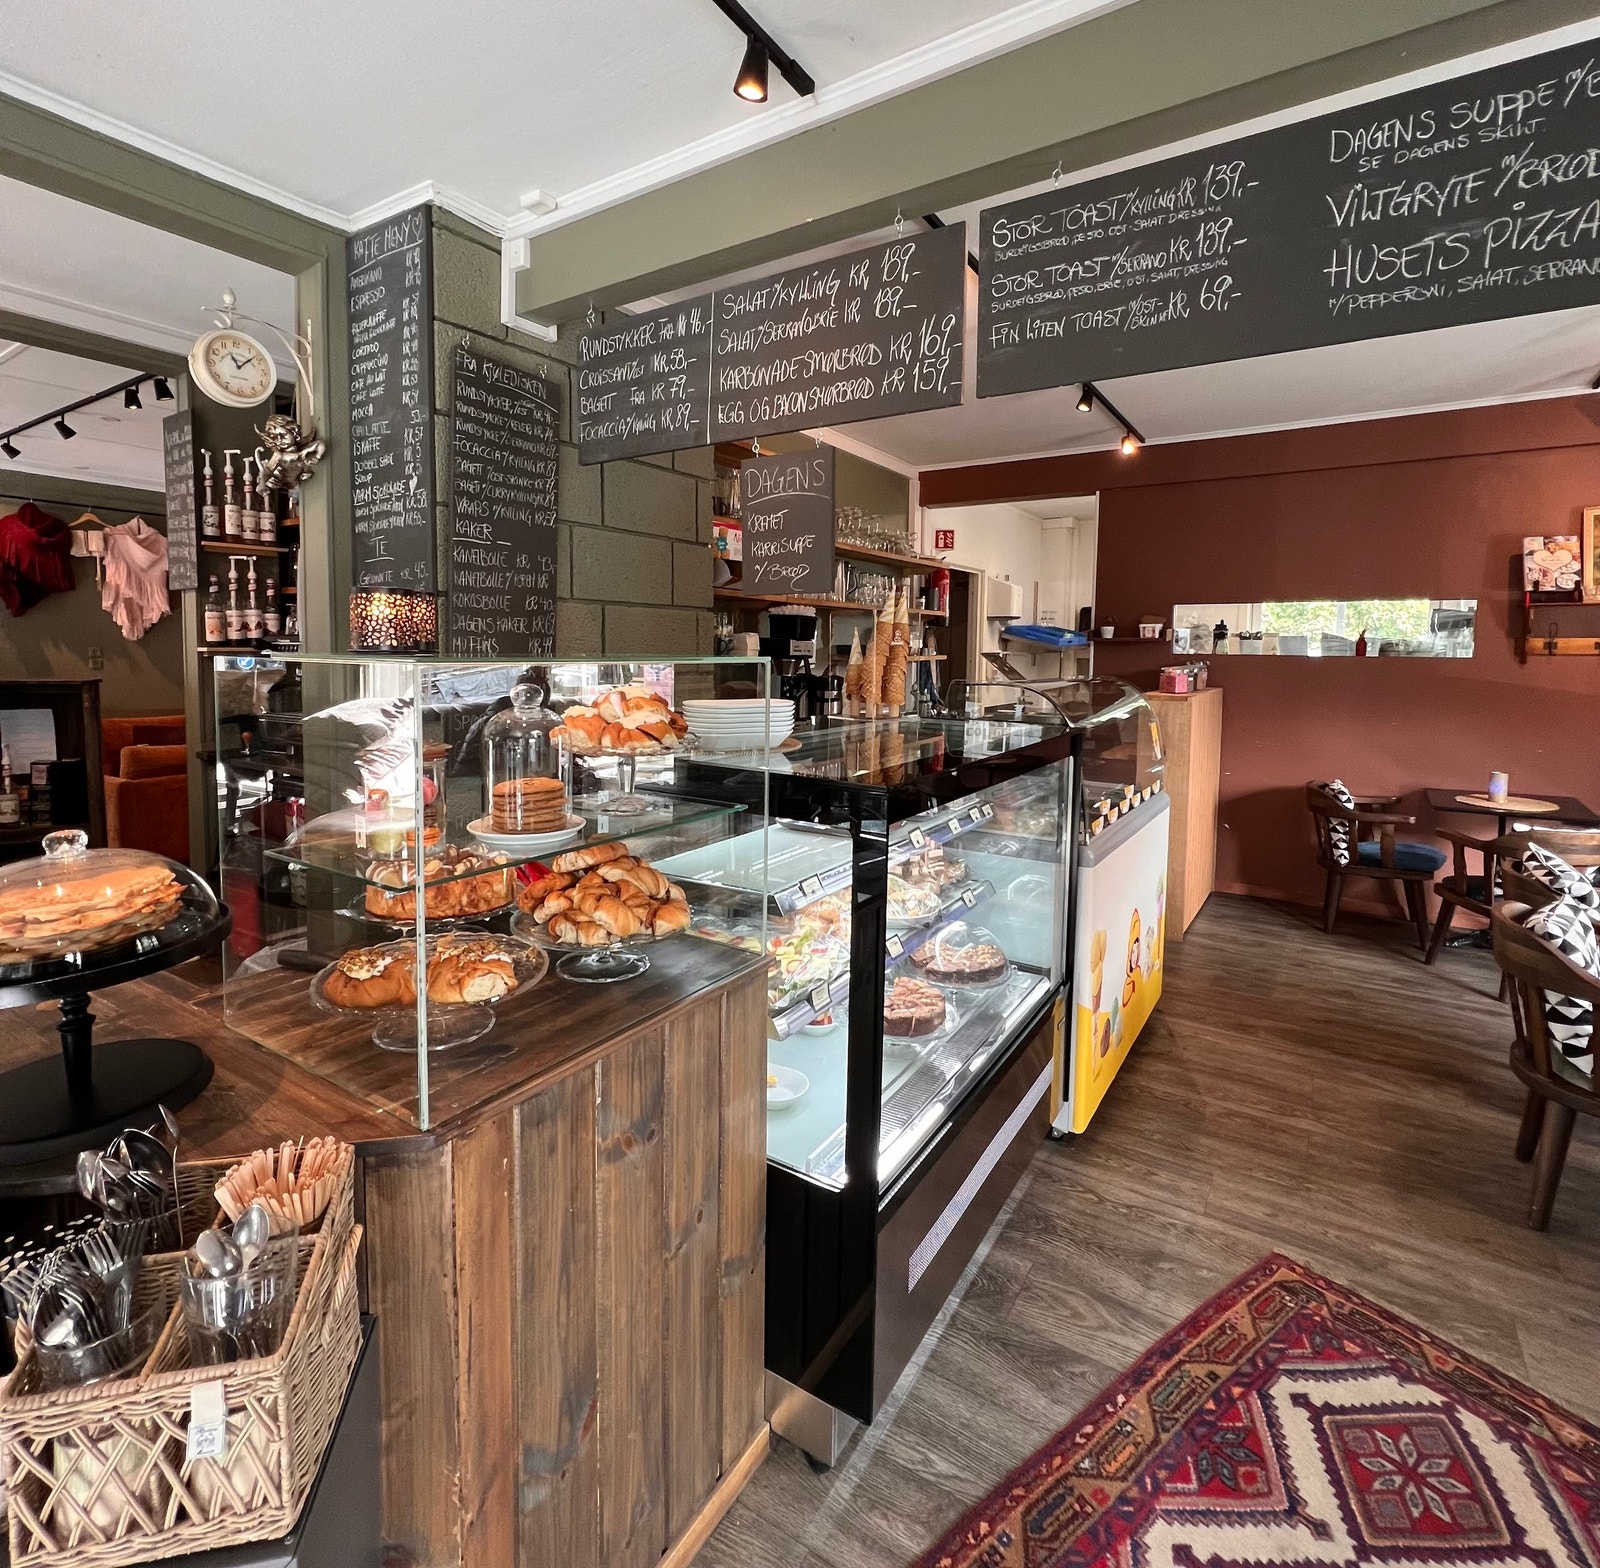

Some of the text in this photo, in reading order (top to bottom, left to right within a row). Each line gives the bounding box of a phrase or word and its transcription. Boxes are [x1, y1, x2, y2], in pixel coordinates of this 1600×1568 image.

[1331, 110, 1436, 163] DAGENS
[1450, 79, 1559, 129] SUPPE
[1358, 156, 1385, 172] SE
[1394, 136, 1470, 164] DAGENS
[993, 214, 1053, 248] STOR
[1050, 193, 1127, 232] TOAST
[1323, 199, 1600, 289] HUSETS PIZZA
[991, 270, 1044, 297] STOR
[1044, 256, 1111, 285] TOAST
[722, 288, 771, 319] SALAT
[1071, 306, 1127, 332] TOAST
[1200, 275, 1242, 311] 69,-
[718, 327, 755, 355] SALAT
[919, 313, 963, 359] 169,-
[718, 401, 744, 424] EGG
[750, 397, 770, 423] OG
[912, 356, 963, 394] 159,-
[745, 459, 825, 498] DAGENS
[370, 535, 388, 557] TE
[455, 518, 493, 540] KAKER
